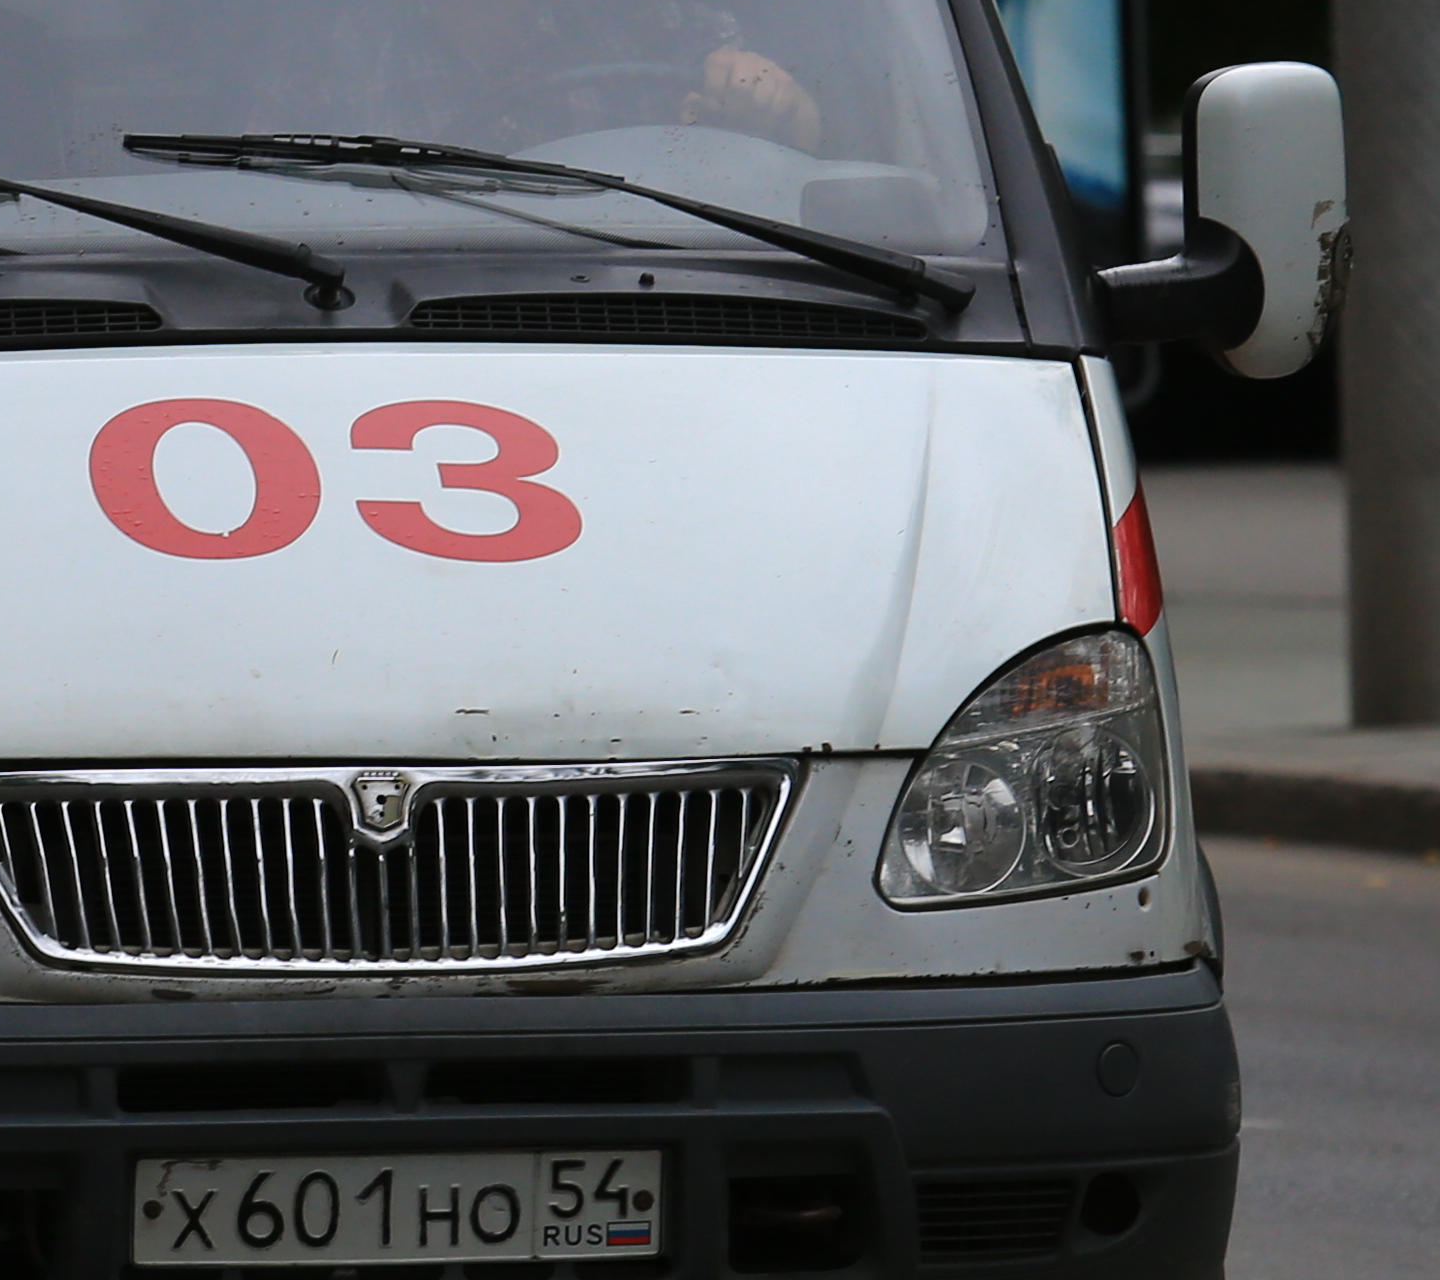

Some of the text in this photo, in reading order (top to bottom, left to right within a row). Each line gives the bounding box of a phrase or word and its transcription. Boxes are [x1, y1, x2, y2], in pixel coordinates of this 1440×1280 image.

[88, 397, 583, 563] 03
[548, 1157, 630, 1220] 54
[542, 1223, 604, 1248] RUS
